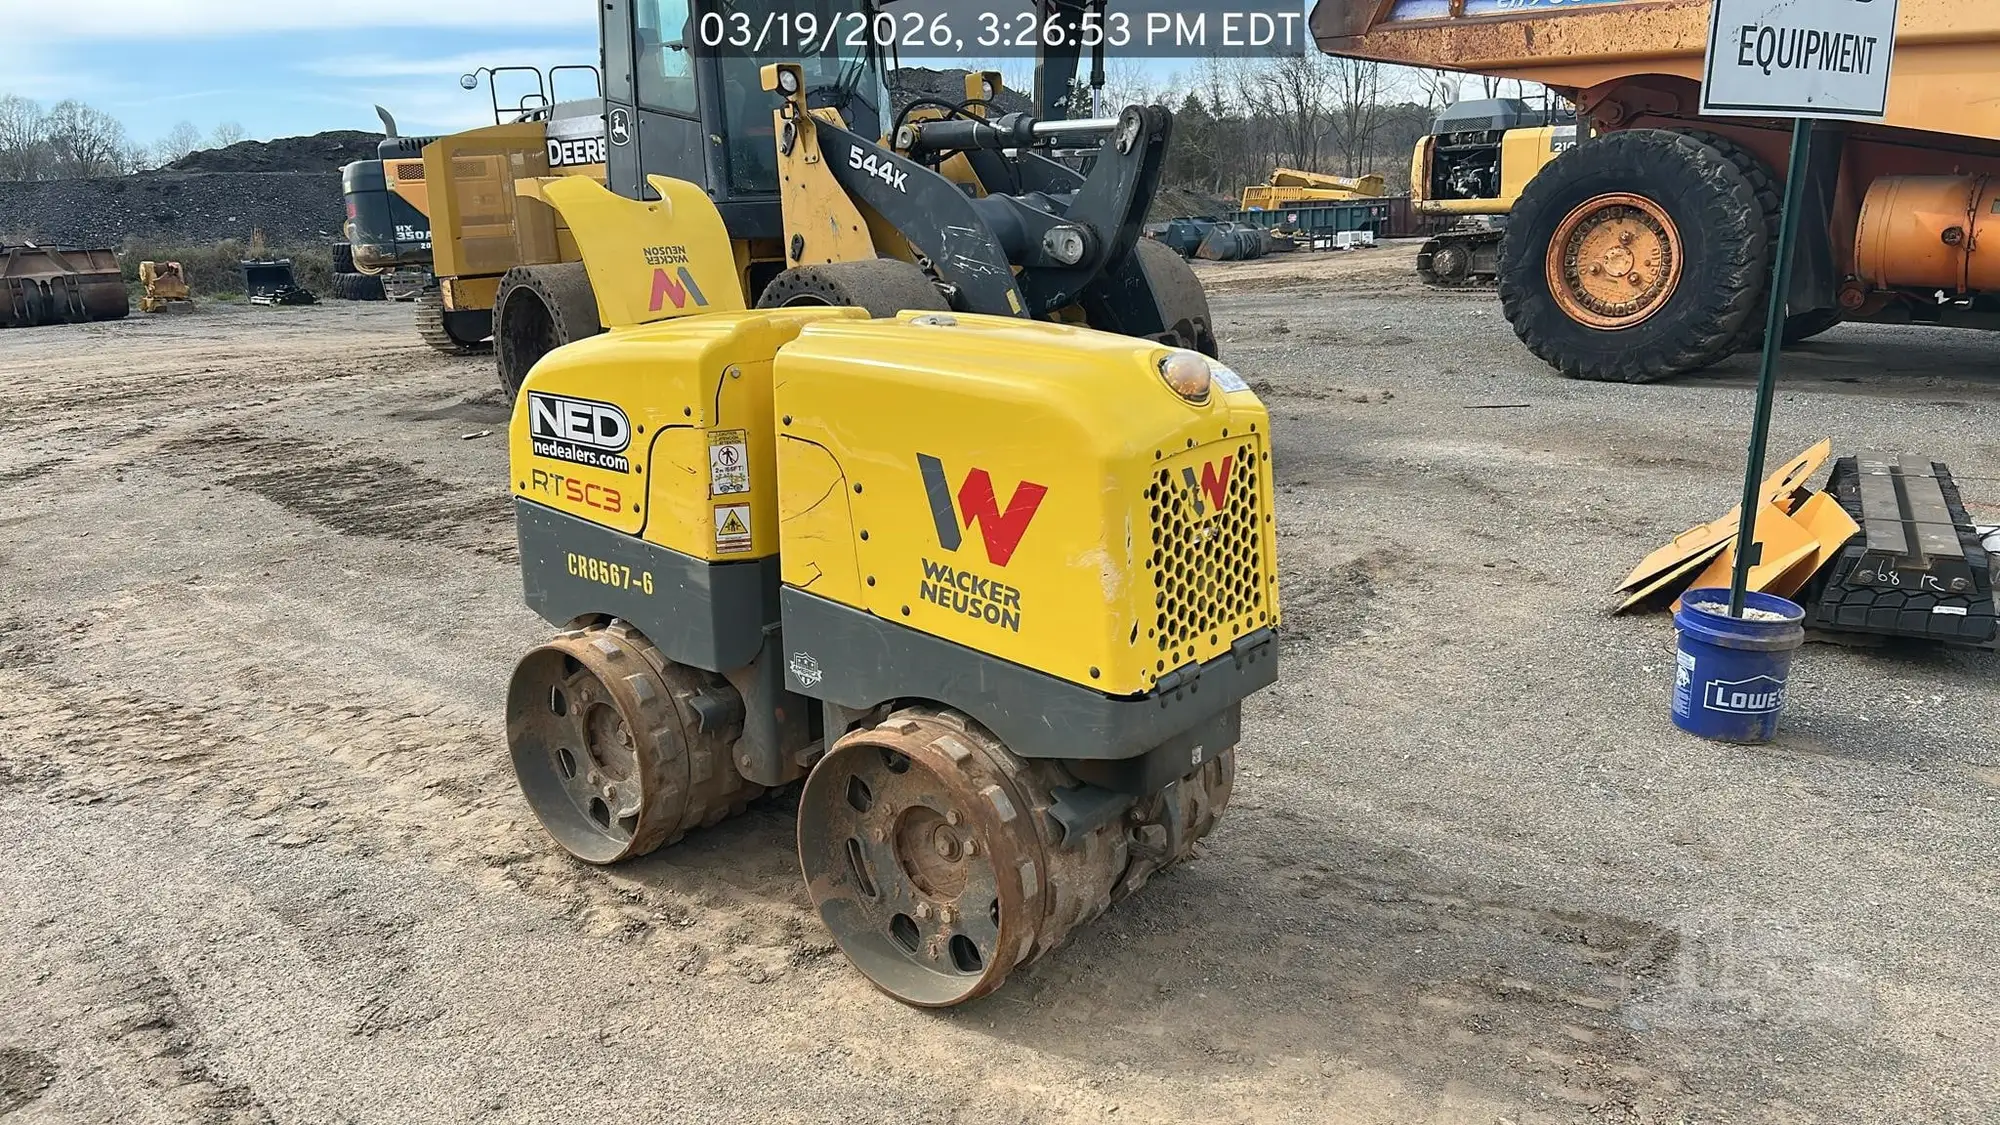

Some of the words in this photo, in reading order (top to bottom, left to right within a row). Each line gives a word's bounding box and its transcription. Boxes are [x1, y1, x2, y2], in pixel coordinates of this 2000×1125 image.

[1738, 25, 1878, 76] EQUIPMENT
[547, 138, 606, 166] DEERE
[849, 144, 908, 193] 544K
[642, 245, 686, 257] NEUSON
[645, 254, 690, 266] WACKER
[531, 396, 627, 448] NED
[534, 440, 628, 472] nedealers.com
[532, 468, 621, 513] RTSC3
[567, 552, 654, 596] CR8567-6
[921, 557, 1021, 611] WACKER
[919, 579, 1021, 633] NEUSON
